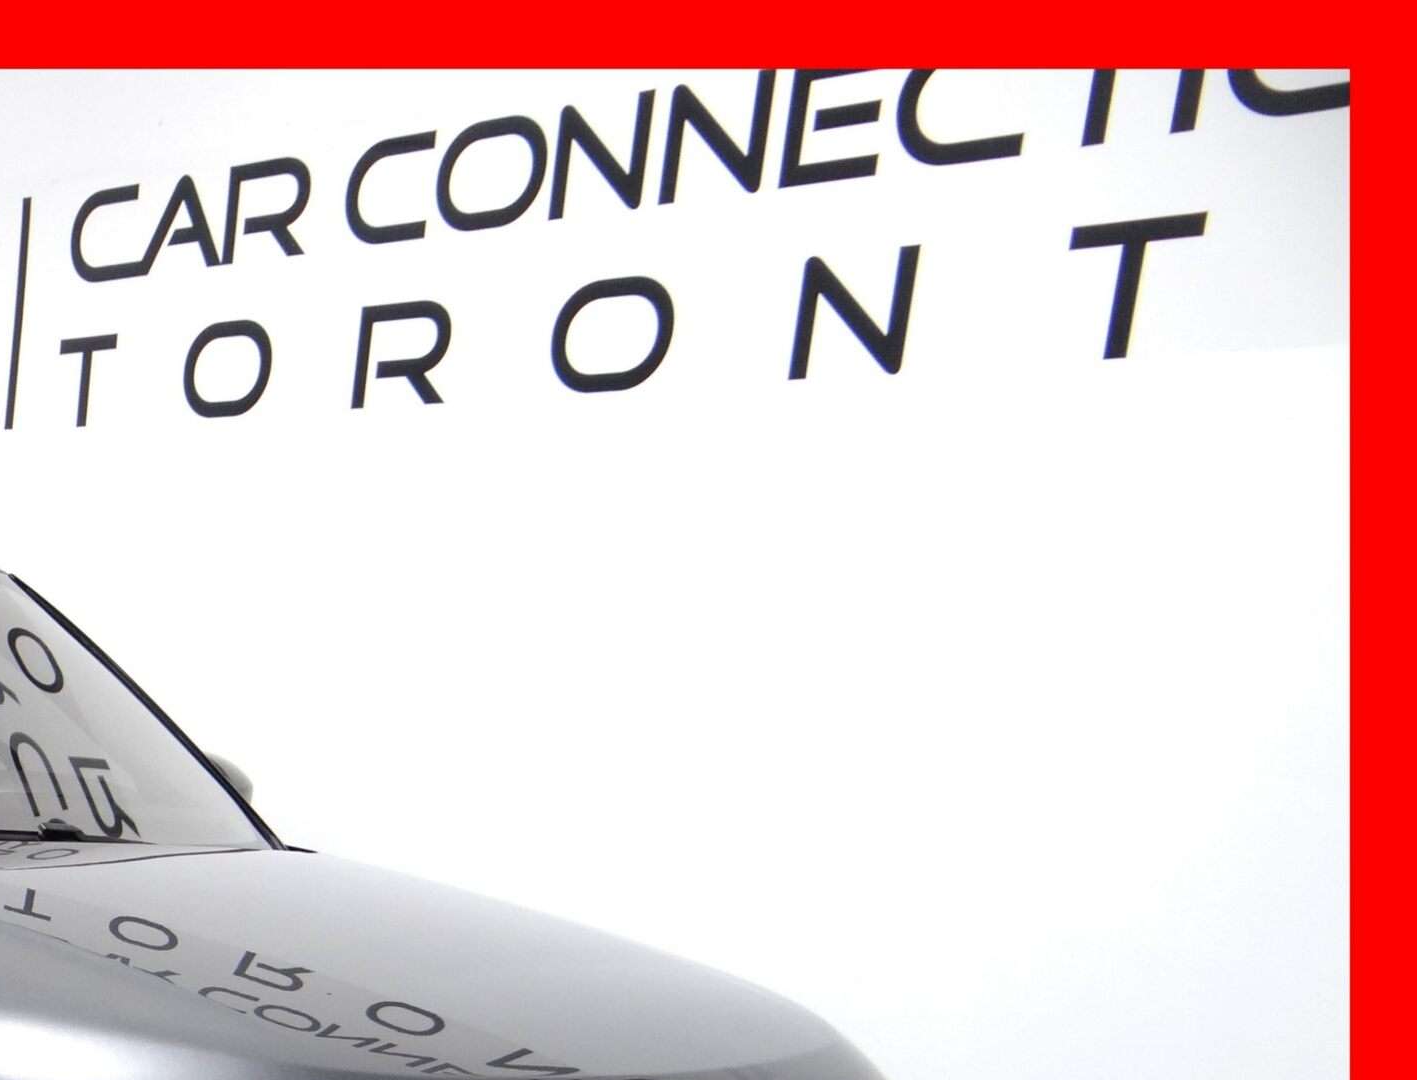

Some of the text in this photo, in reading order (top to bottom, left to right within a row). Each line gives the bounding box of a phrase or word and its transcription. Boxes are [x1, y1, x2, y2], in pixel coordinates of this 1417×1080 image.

[71, 68, 1351, 283] CAR CONNEC
[59, 211, 1208, 427] TORONT
